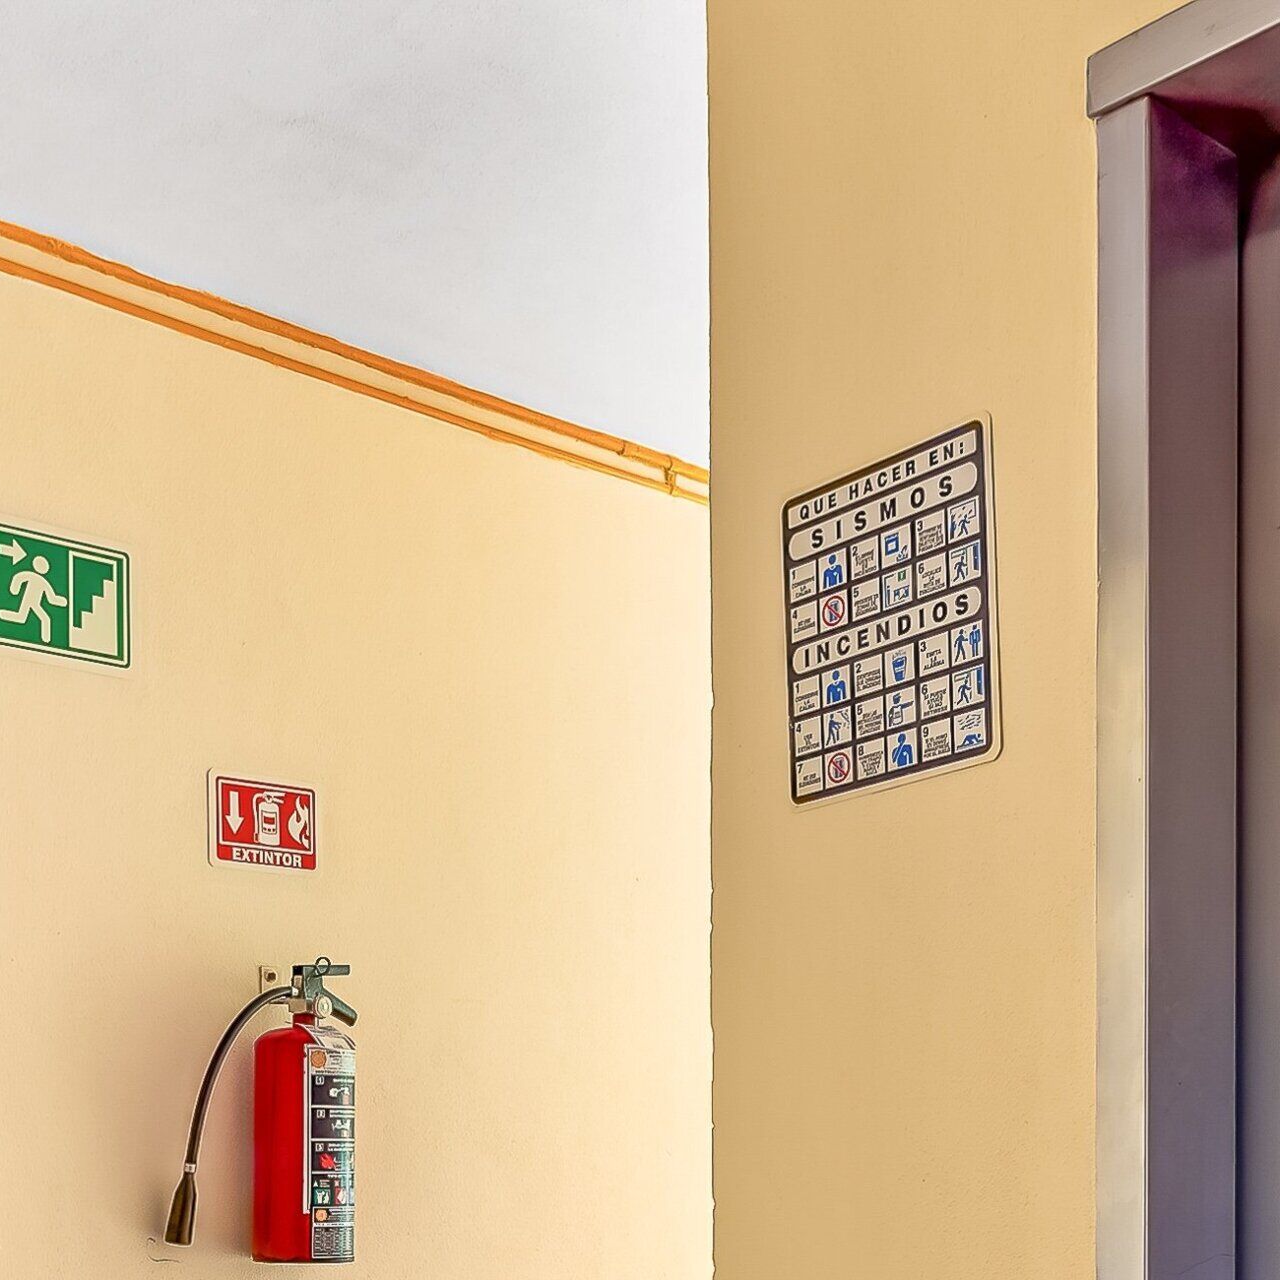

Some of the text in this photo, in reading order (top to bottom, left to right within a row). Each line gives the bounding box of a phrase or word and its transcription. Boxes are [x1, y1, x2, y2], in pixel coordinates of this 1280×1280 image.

[800, 442, 964, 520] QUE HACER EN:
[811, 475, 952, 549] SISMOS
[917, 520, 923, 532] 3
[853, 546, 858, 557] 2
[918, 563, 924, 574] 6
[854, 587, 859, 598] 5
[792, 610, 797, 619] 4
[804, 593, 969, 668] INCENDIOS
[920, 641, 927, 652] 3
[855, 663, 861, 674] 2
[922, 684, 928, 695] 6
[857, 704, 863, 715] 5
[796, 723, 801, 732] 4
[923, 727, 928, 738] 9
[858, 745, 864, 756] 8
[797, 763, 803, 774] 7
[232, 848, 302, 868] EXTINTOR
